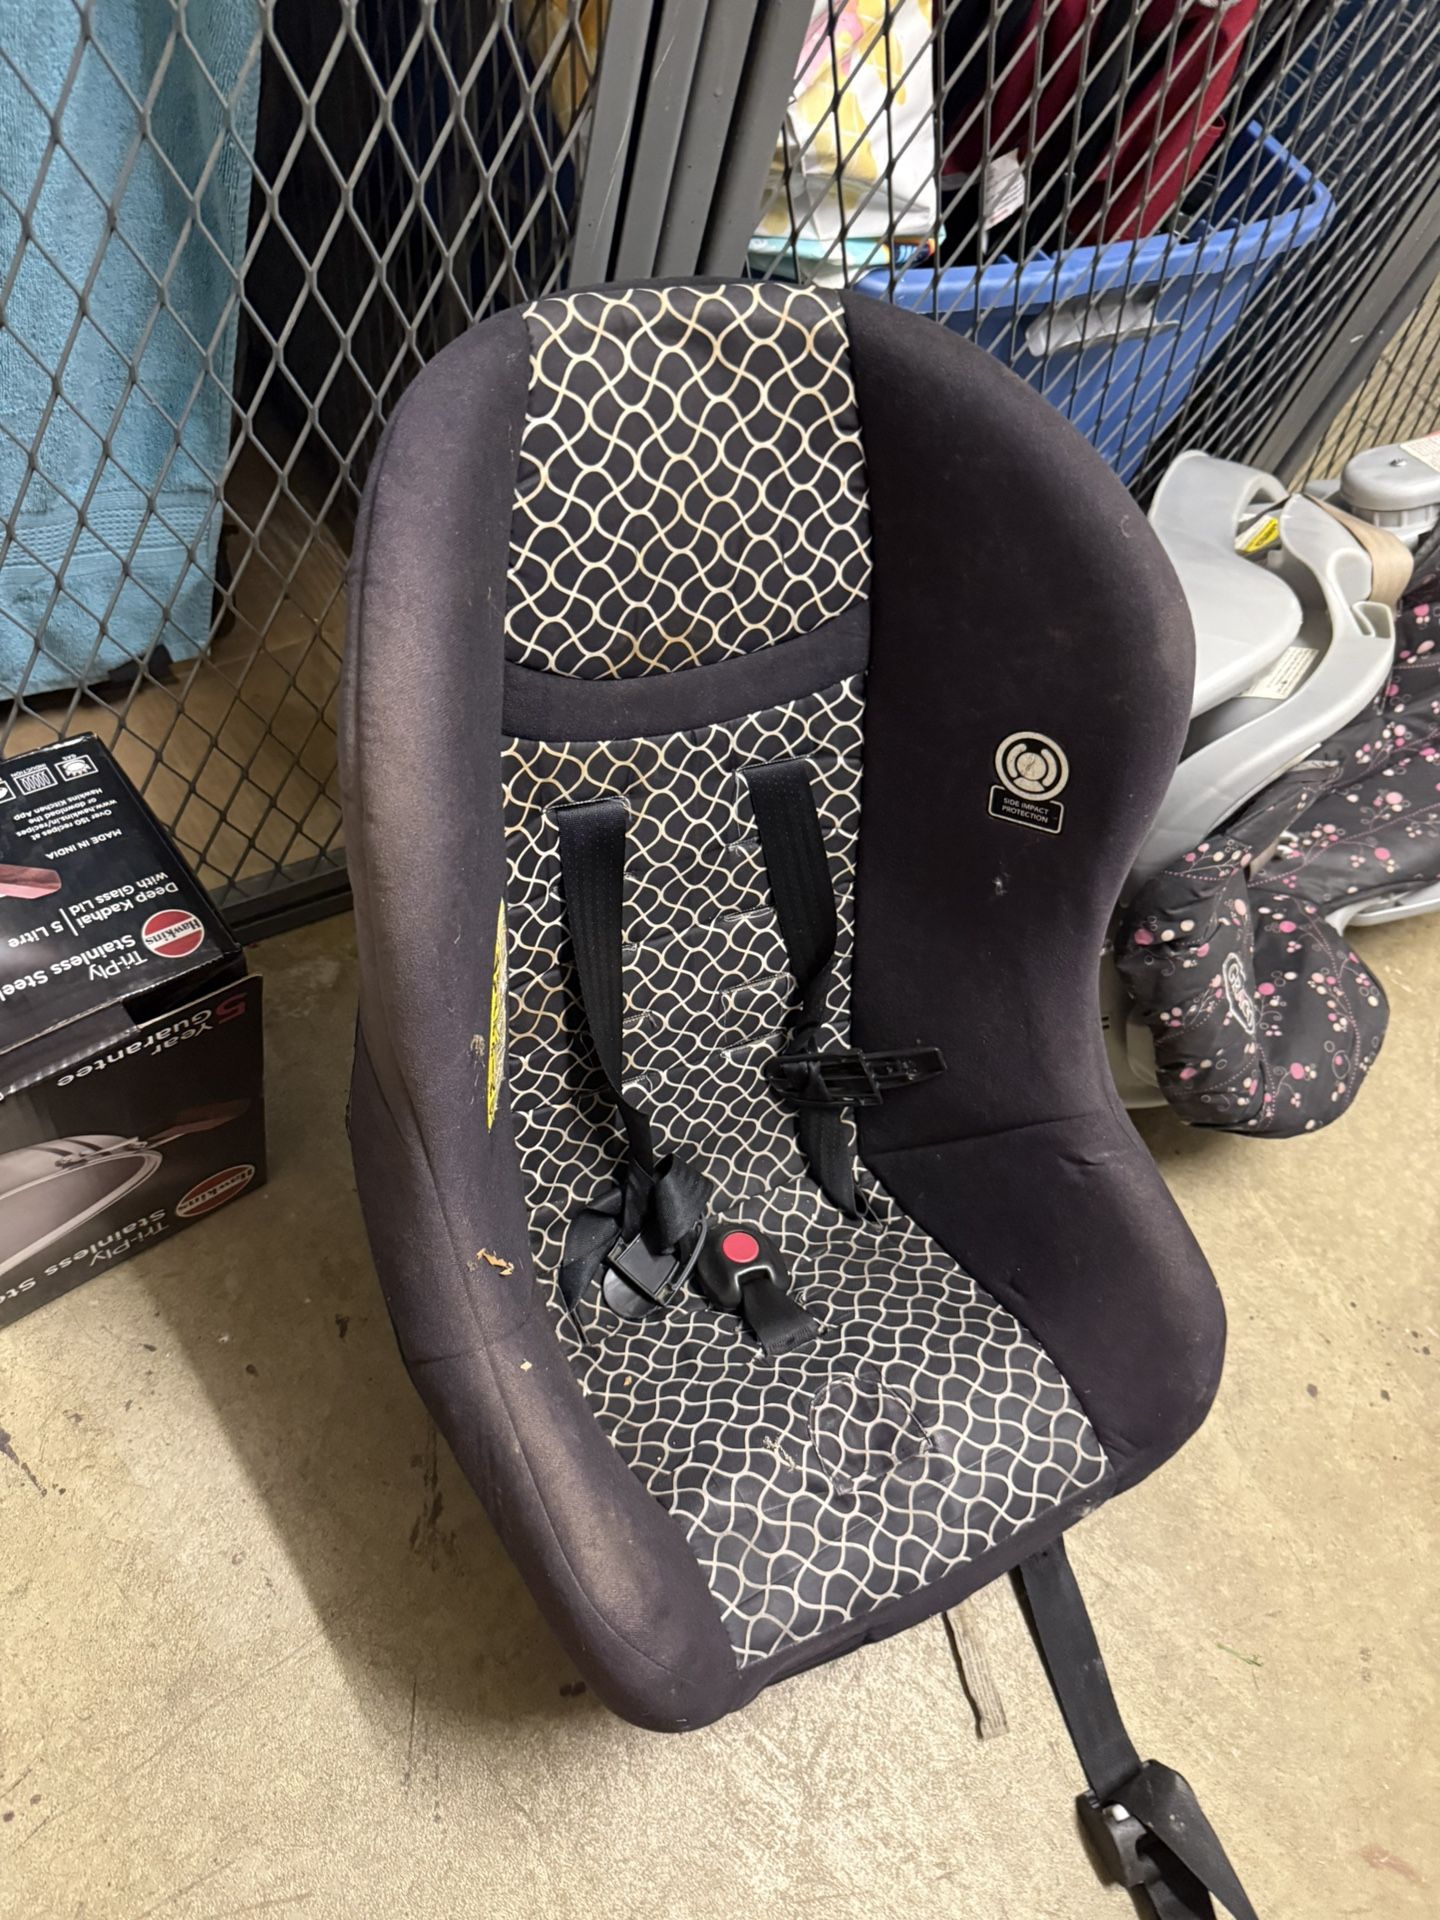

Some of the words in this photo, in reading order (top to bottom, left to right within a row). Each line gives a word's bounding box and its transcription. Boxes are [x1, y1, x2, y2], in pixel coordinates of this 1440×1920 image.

[67, 788, 103, 802] Hawkins
[34, 798, 67, 813] Kitchen
[44, 801, 86, 819] download
[91, 809, 112, 820] Over
[1001, 805, 1049, 824] PROTECTION
[1003, 797, 1020, 808] SIDE
[1021, 800, 1049, 815] IMPACT
[13, 810, 32, 821] App
[16, 799, 118, 837] www.hawkins.in/recipes
[28, 815, 44, 824] the
[74, 816, 91, 826] 150
[30, 832, 41, 840] at
[42, 823, 74, 837] recipes
[93, 828, 122, 844] MADE
[45, 844, 78, 860] INDIA
[79, 839, 91, 849] IN
[138, 872, 168, 889] with
[95, 885, 135, 904] Glass
[135, 882, 179, 903] Deep
[68, 899, 95, 916] Lid
[77, 899, 134, 929] Kadhai
[51, 920, 64, 933] 5
[145, 918, 201, 945] Hawkins
[8, 927, 49, 948] Litre
[50, 934, 136, 975] Stainless
[89, 950, 148, 981] Tri-Ply
[215, 992, 248, 1025] 5
[56, 1009, 213, 1087] Guarantee
[151, 1022, 214, 1056] Year
[43, 1208, 167, 1277] Stainless
[89, 1223, 171, 1267] Tri-Ply
